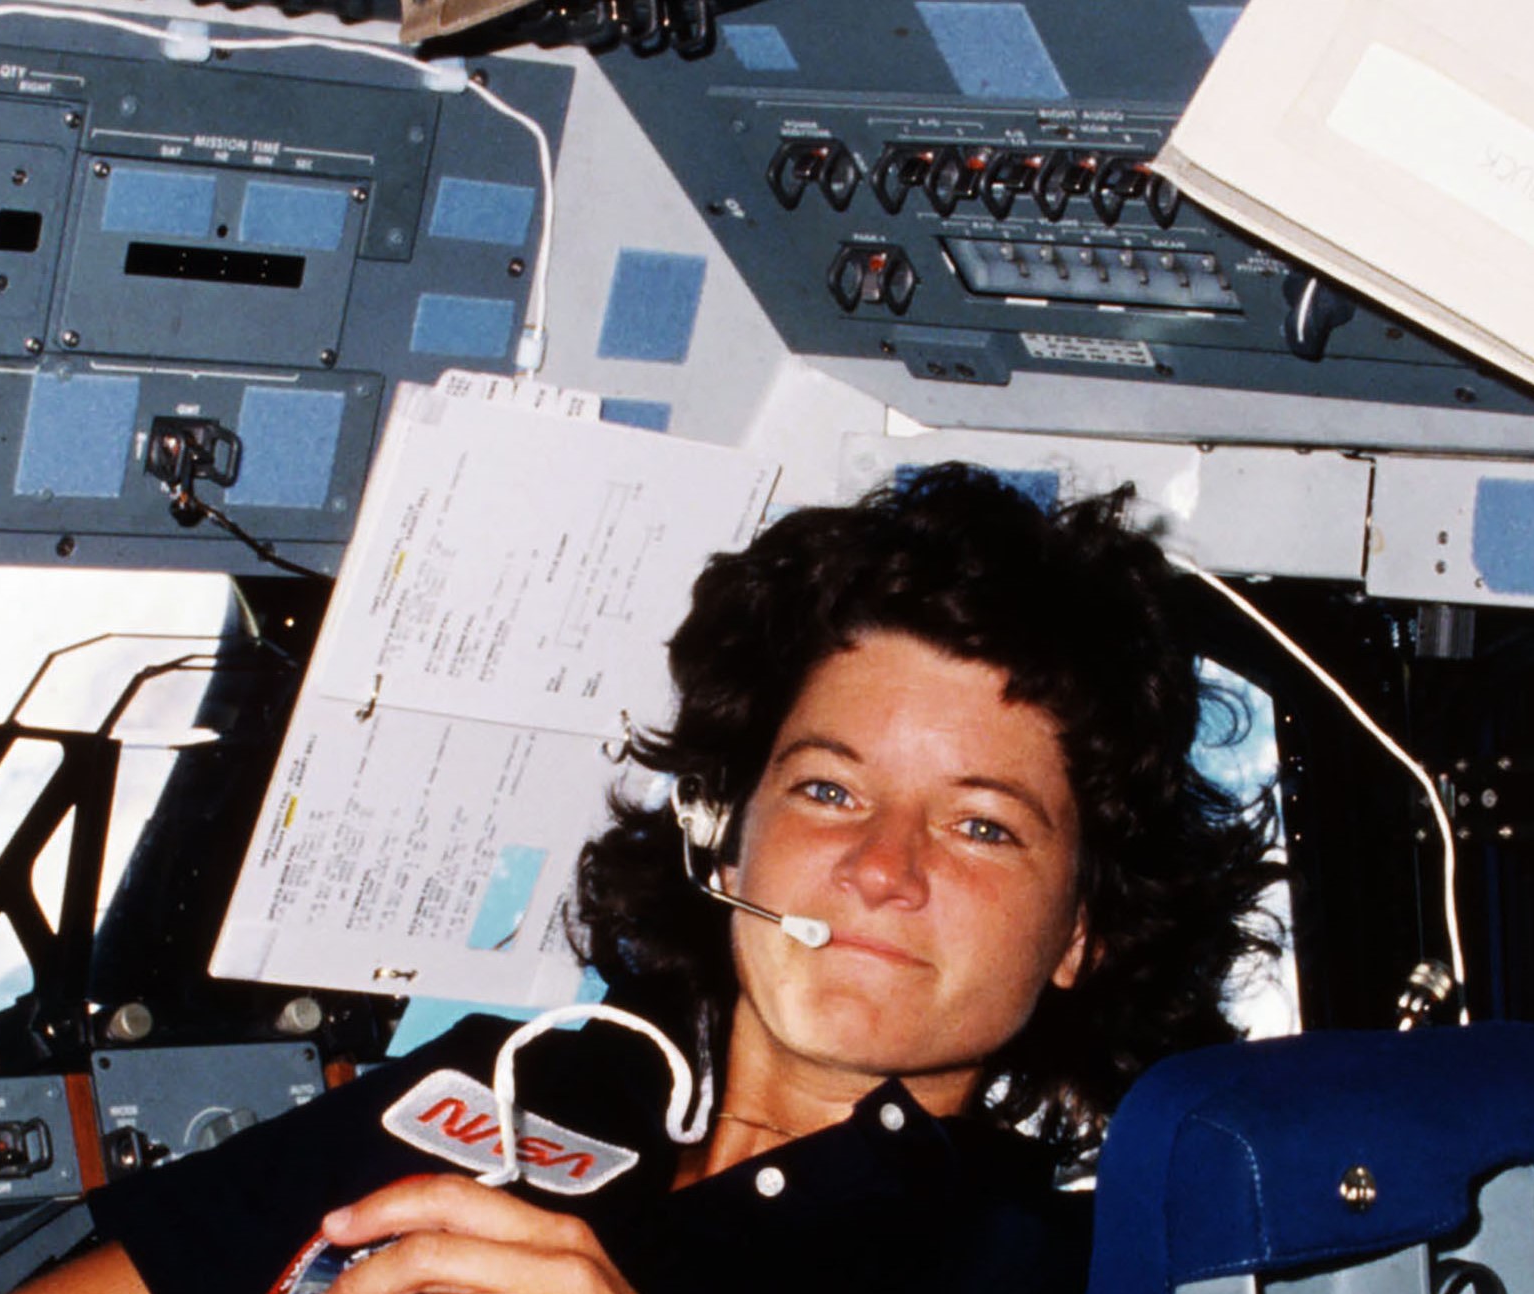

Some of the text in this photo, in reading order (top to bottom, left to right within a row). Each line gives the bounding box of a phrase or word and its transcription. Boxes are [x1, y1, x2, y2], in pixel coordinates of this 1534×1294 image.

[19, 80, 52, 94] RIGHT
[194, 135, 281, 155] MISSION TIME
[416, 1096, 597, 1180] NASA
